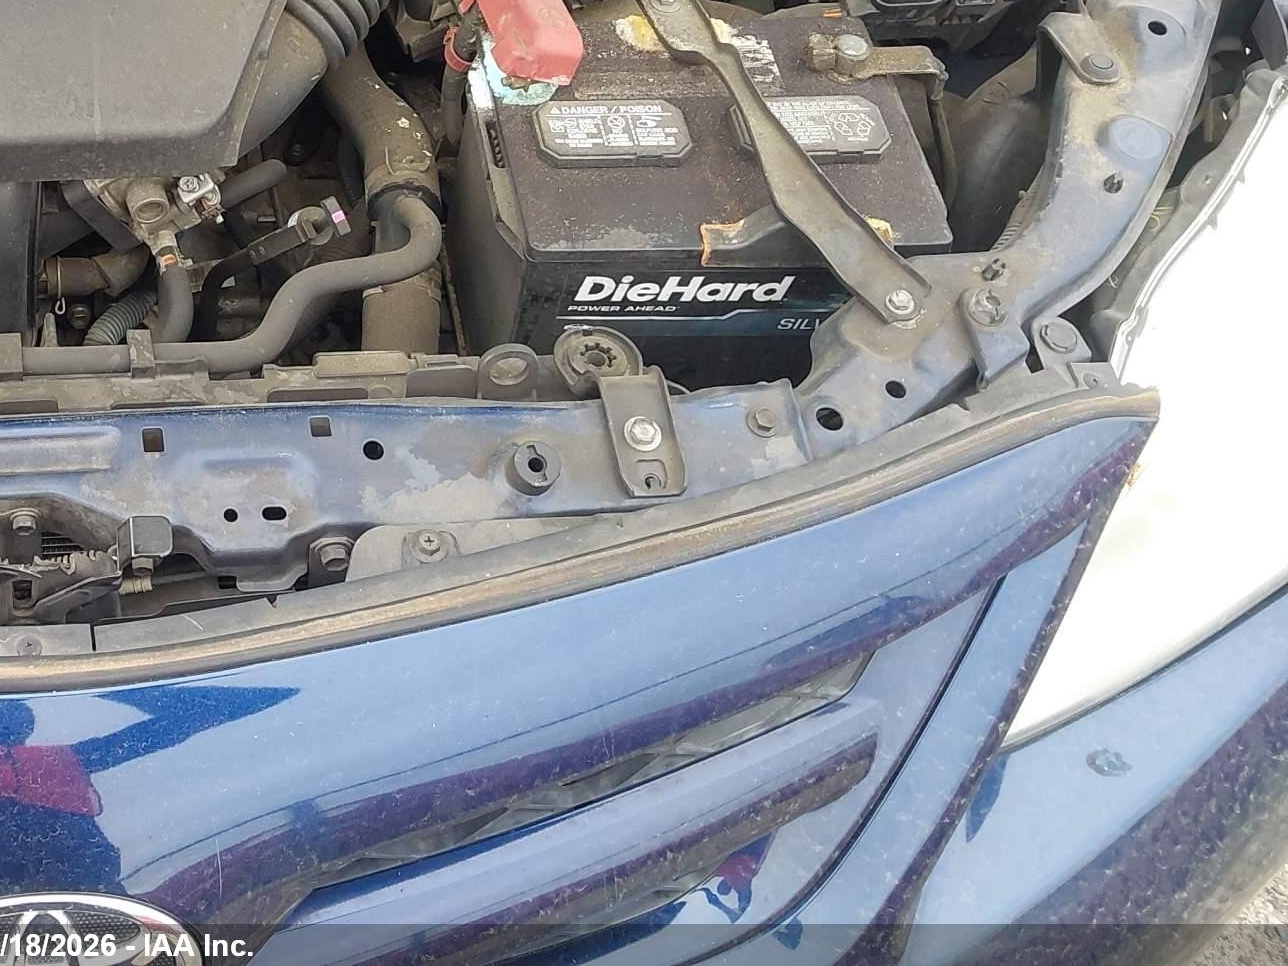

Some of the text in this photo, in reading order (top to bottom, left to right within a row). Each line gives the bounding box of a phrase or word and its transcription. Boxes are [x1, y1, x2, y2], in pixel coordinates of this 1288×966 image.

[561, 105, 608, 114] DANGER
[619, 104, 662, 113] POISON
[574, 275, 797, 302] DieHard
